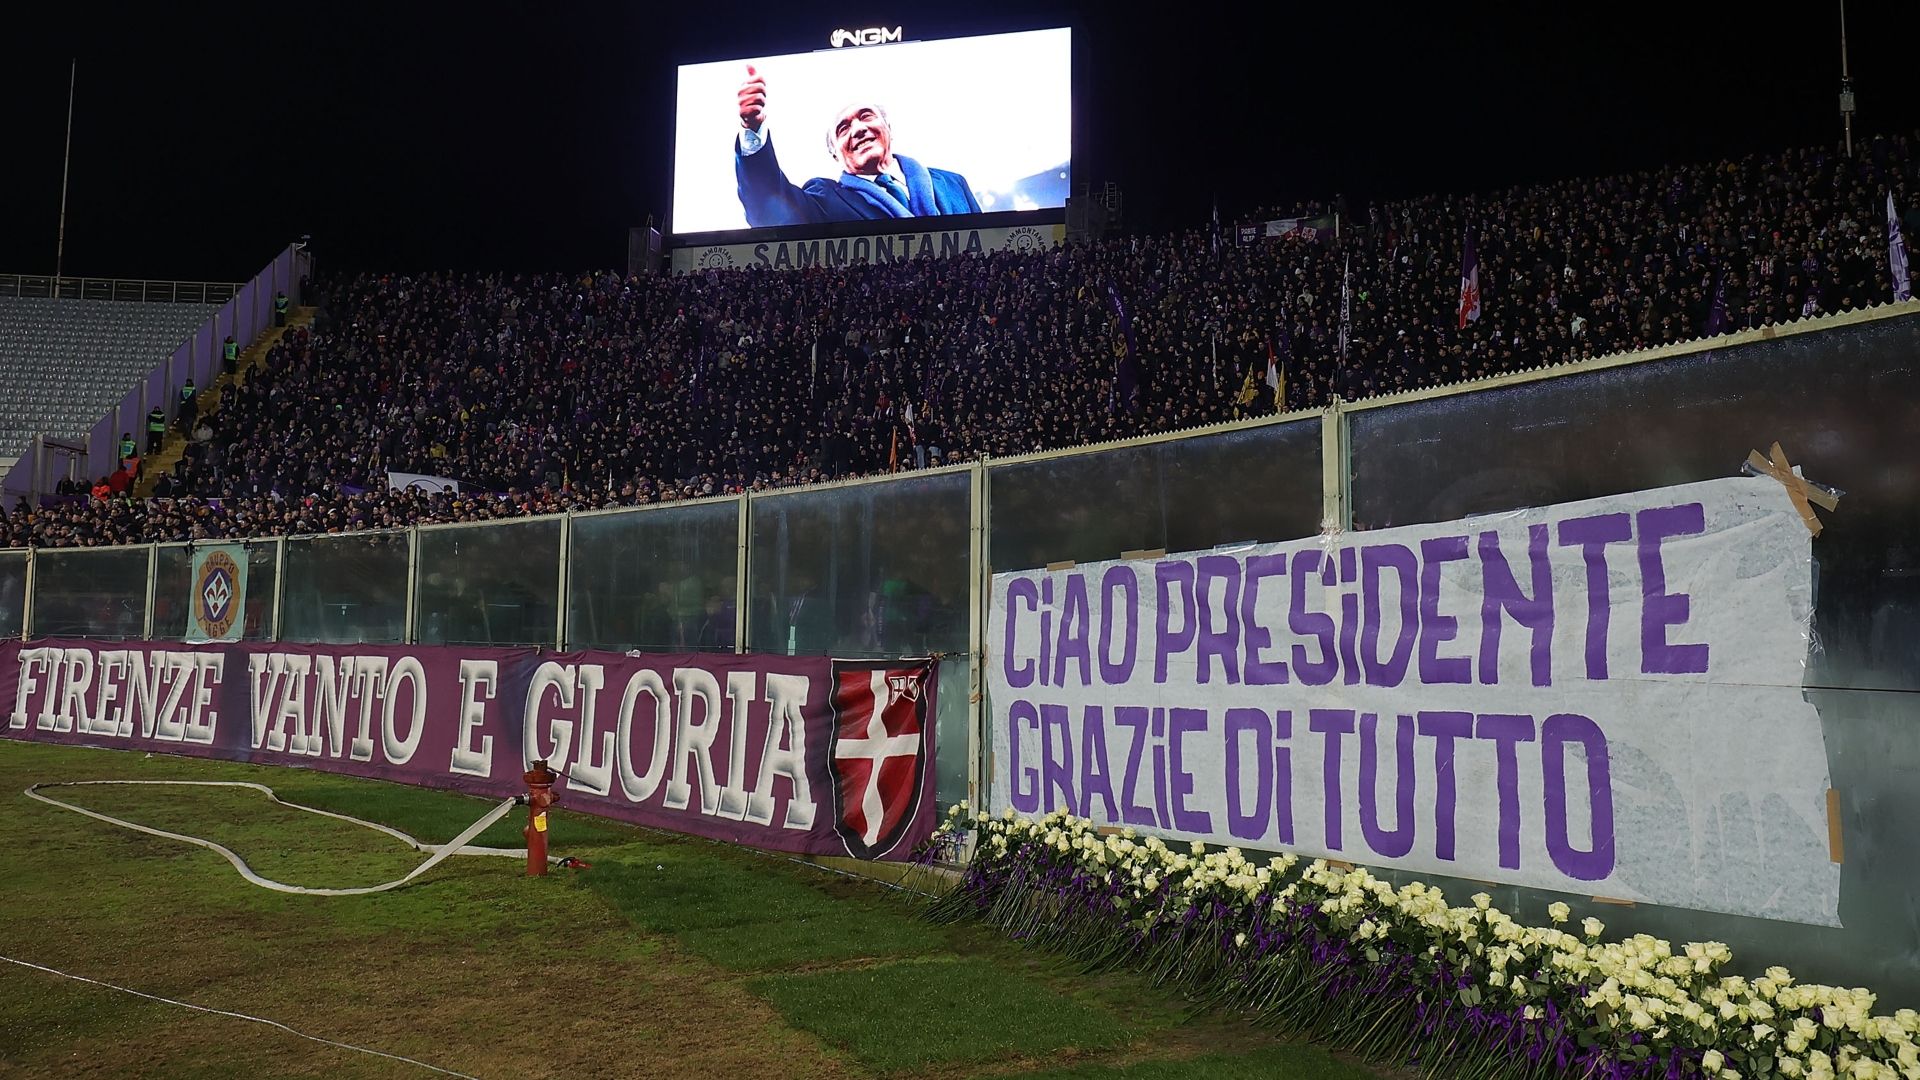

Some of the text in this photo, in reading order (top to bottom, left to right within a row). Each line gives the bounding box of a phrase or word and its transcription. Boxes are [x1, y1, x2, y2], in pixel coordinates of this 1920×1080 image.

[830, 25, 902, 47] NGM
[754, 230, 984, 269] SAMMONTANA
[1005, 227, 1045, 248] SAMMONTANA
[698, 246, 734, 267] SAMMONTANA
[9, 647, 817, 831] FIRENZE VANTO E GLORIA
[1309, 709, 1616, 882] TUTTO
